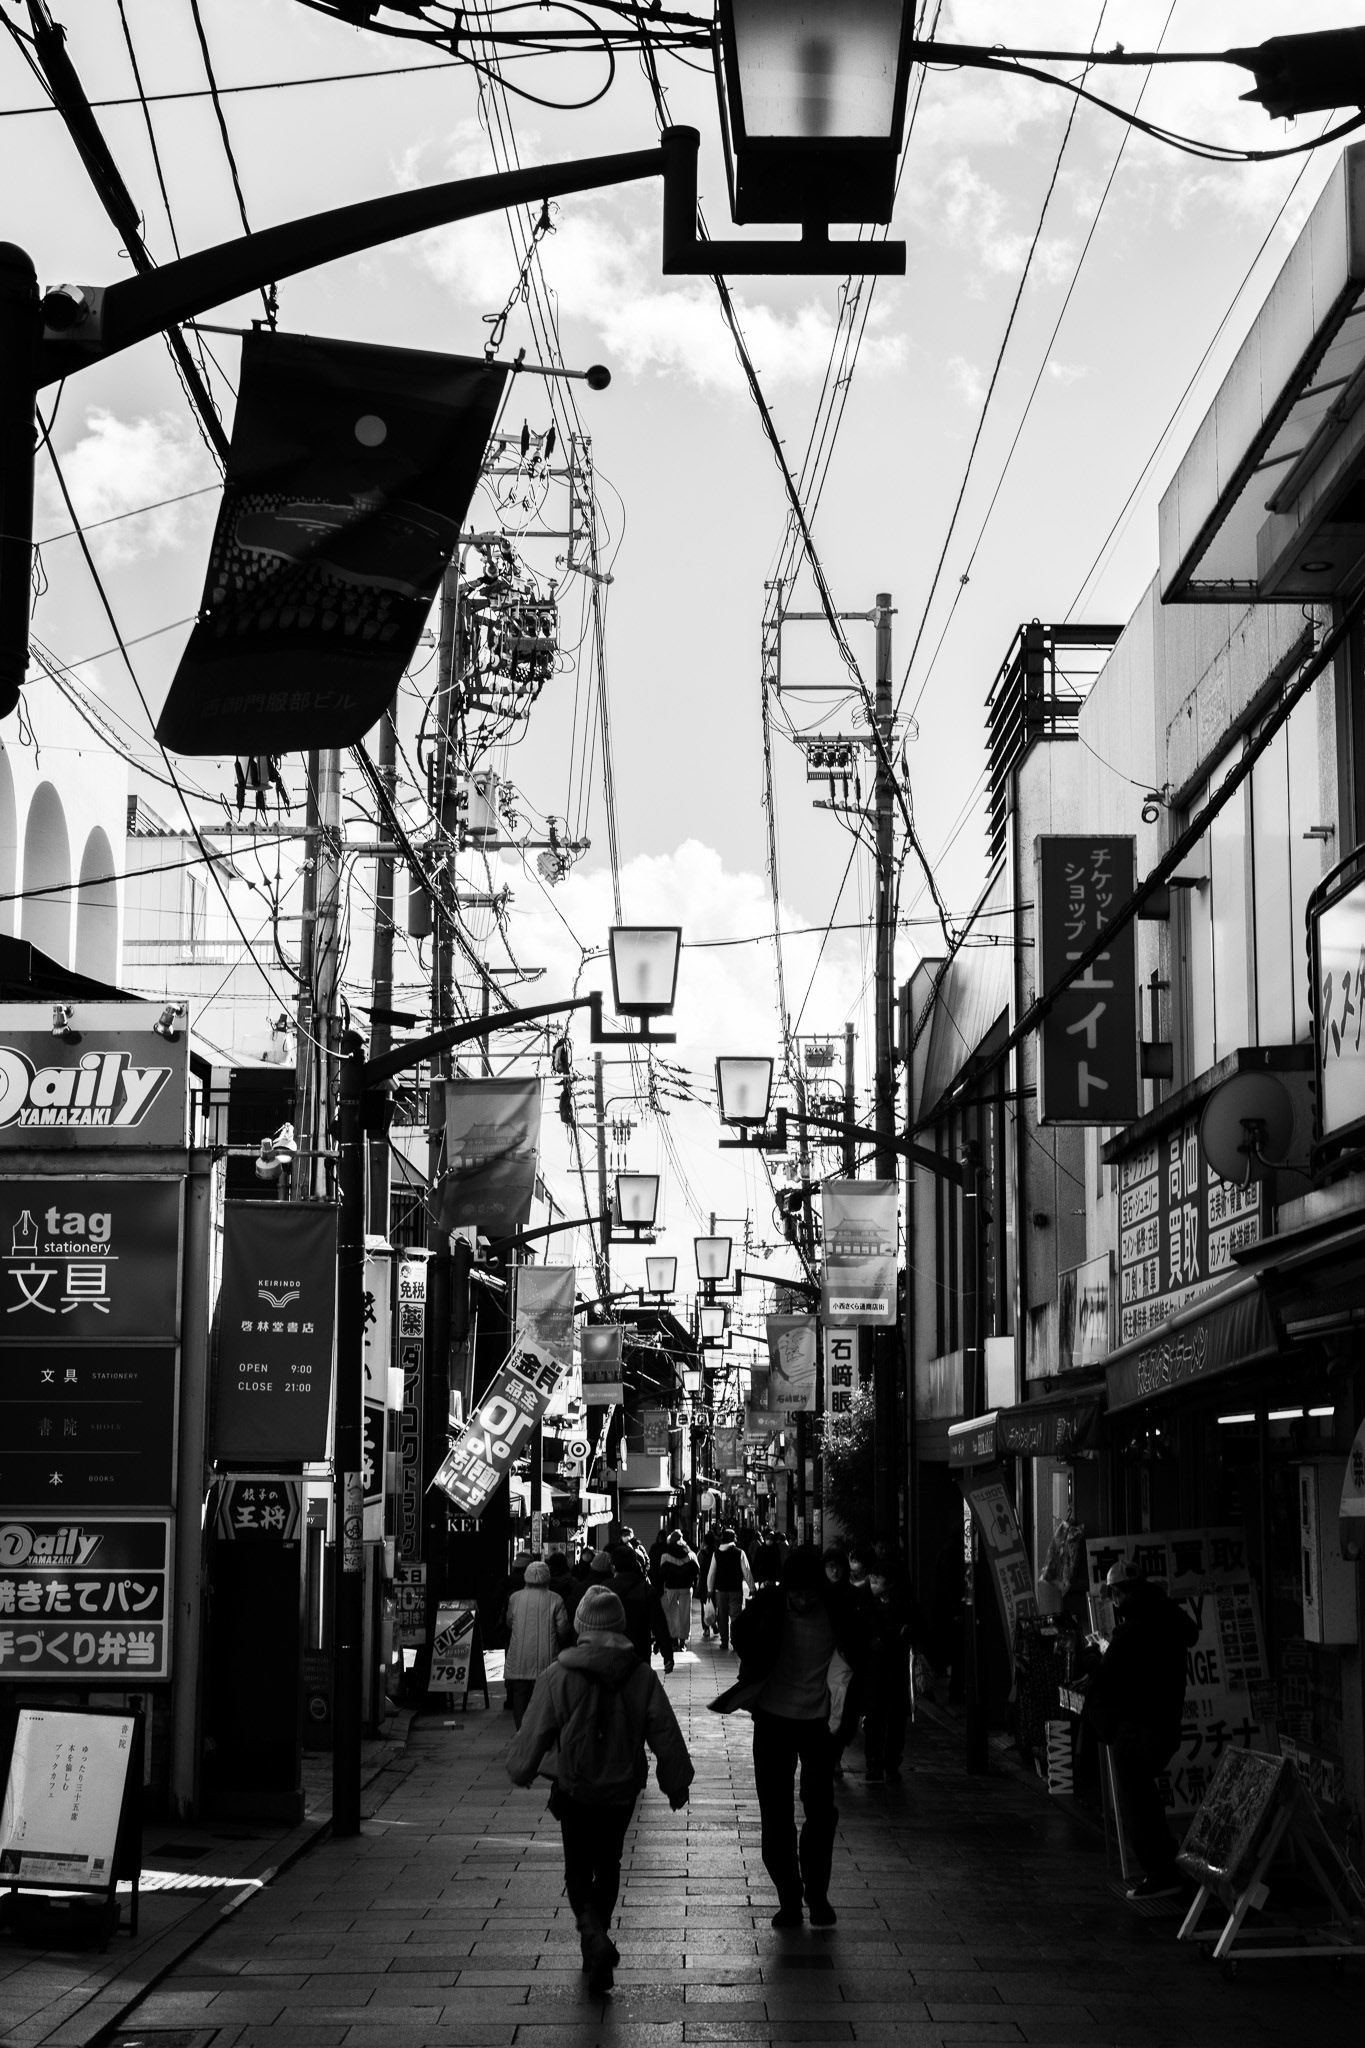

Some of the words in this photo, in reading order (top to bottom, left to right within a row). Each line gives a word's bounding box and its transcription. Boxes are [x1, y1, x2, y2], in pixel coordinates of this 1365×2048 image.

[1064, 863, 1086, 941] ショップ
[1090, 849, 1113, 930] チケット
[1066, 952, 1114, 1108] エイト
[19, 1107, 111, 1125] YAMAZAKI
[45, 1206, 112, 1241] tag
[44, 1242, 111, 1257] stationery
[1168, 1203, 1200, 1288] 買取
[6, 1263, 111, 1314] 文具
[258, 1279, 302, 1288] KEIRINDO
[400, 1281, 425, 1299] 免税
[241, 1320, 314, 1334] 啓林堂書店
[401, 1304, 423, 1335] 薬
[41, 1368, 78, 1383] 文具
[92, 1372, 138, 1380] STATIONERY
[239, 1363, 268, 1373] OPEN
[291, 1364, 313, 1374] 9:00
[238, 1381, 273, 1392] CLOSE
[285, 1382, 311, 1392] 21:00
[38, 1417, 78, 1437] 書院
[242, 1488, 278, 1501] 餃子の
[234, 1505, 286, 1529] 王将
[0, 1523, 104, 1566] Daily
[27, 1555, 73, 1565] YAMAZAKI
[1090, 1538, 1244, 1583] 高価買取
[398, 1570, 421, 1583] 本日
[394, 1587, 425, 1610] 10%
[434, 1625, 461, 1654] EVE
[1180, 1718, 1260, 1761] ラチナ
[48, 1744, 62, 1798] ブックカフェ
[62, 1744, 76, 1791] 本を愉しむ
[70, 1745, 89, 1821] ゆったり三十五席
